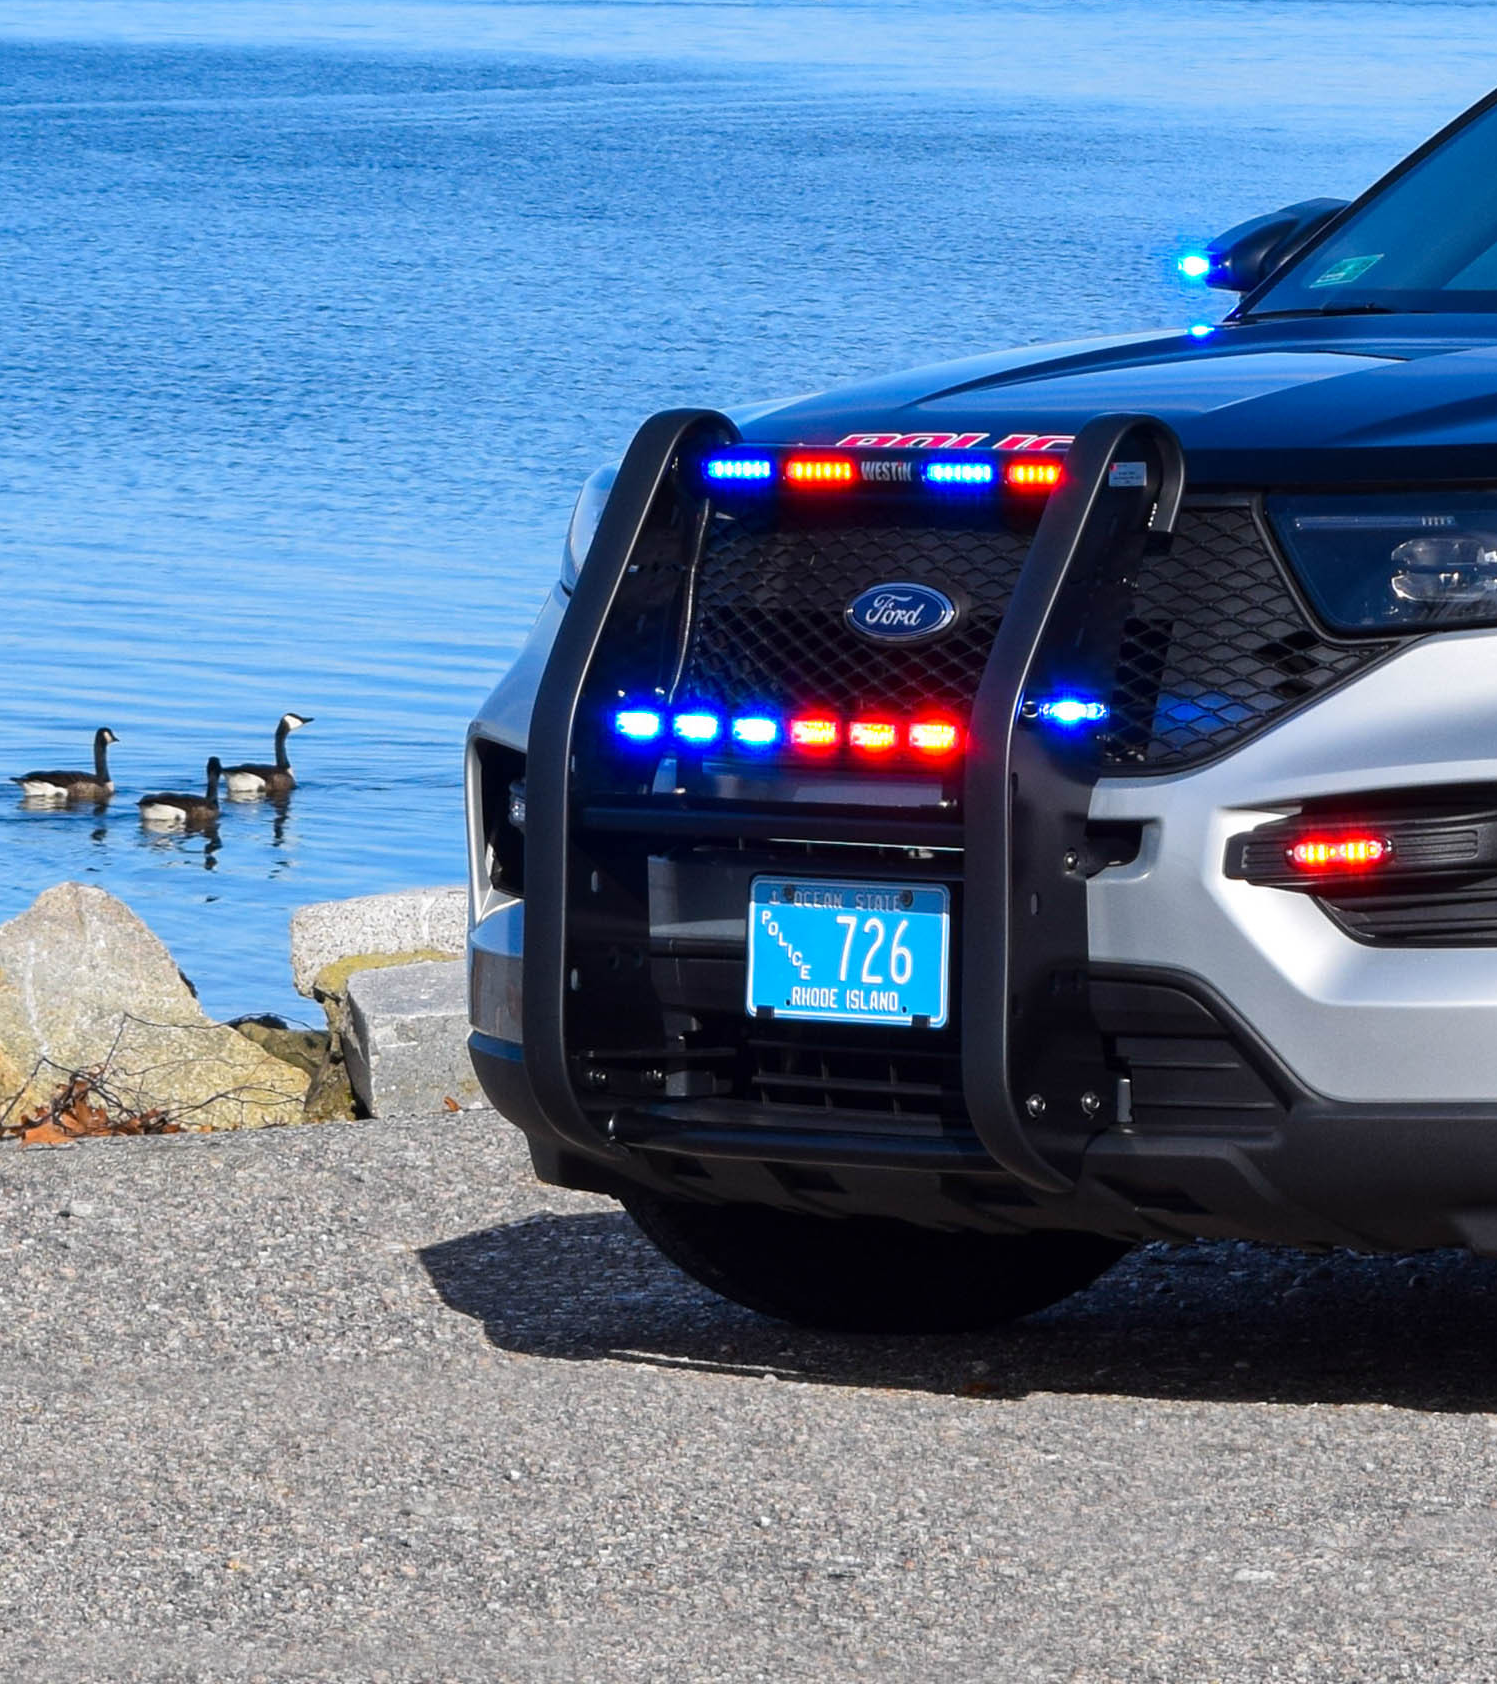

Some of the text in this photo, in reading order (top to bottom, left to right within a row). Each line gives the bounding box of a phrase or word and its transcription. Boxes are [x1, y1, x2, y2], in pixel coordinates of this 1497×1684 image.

[865, 593, 926, 626] Ford
[793, 890, 902, 912] OCEAN STATE
[761, 910, 812, 980] POLICE
[836, 914, 913, 985] 726
[791, 986, 899, 1012] RHODE ISLAND
